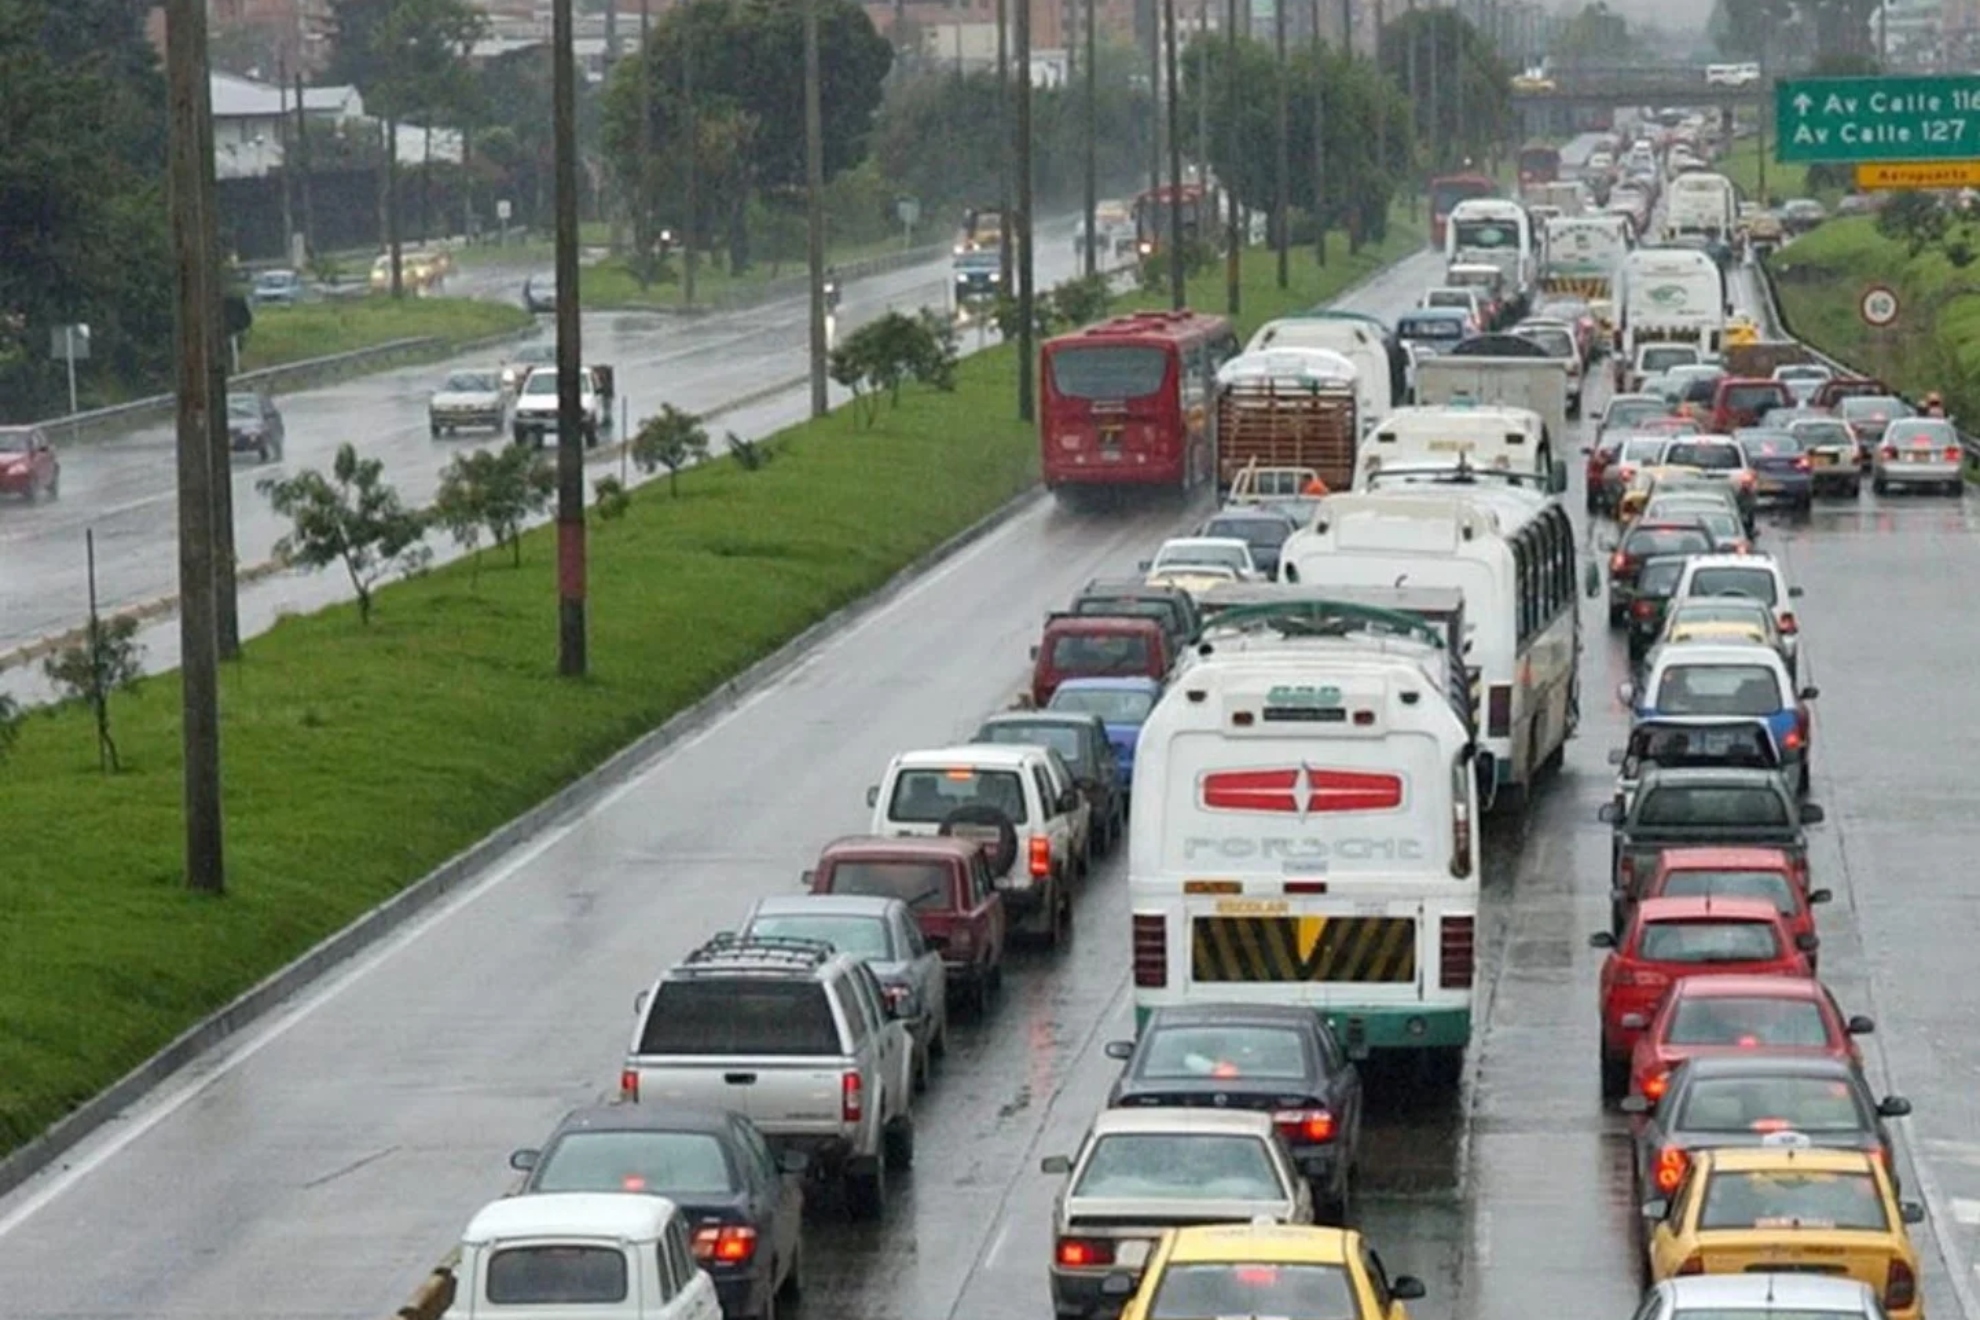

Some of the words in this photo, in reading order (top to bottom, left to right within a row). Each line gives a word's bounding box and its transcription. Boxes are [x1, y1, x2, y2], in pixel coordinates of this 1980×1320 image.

[1823, 93, 1858, 114] Av
[1869, 92, 1941, 113] Calle
[1793, 124, 1829, 144] Av
[1840, 123, 1911, 143] Calle
[1922, 119, 1966, 141] 127
